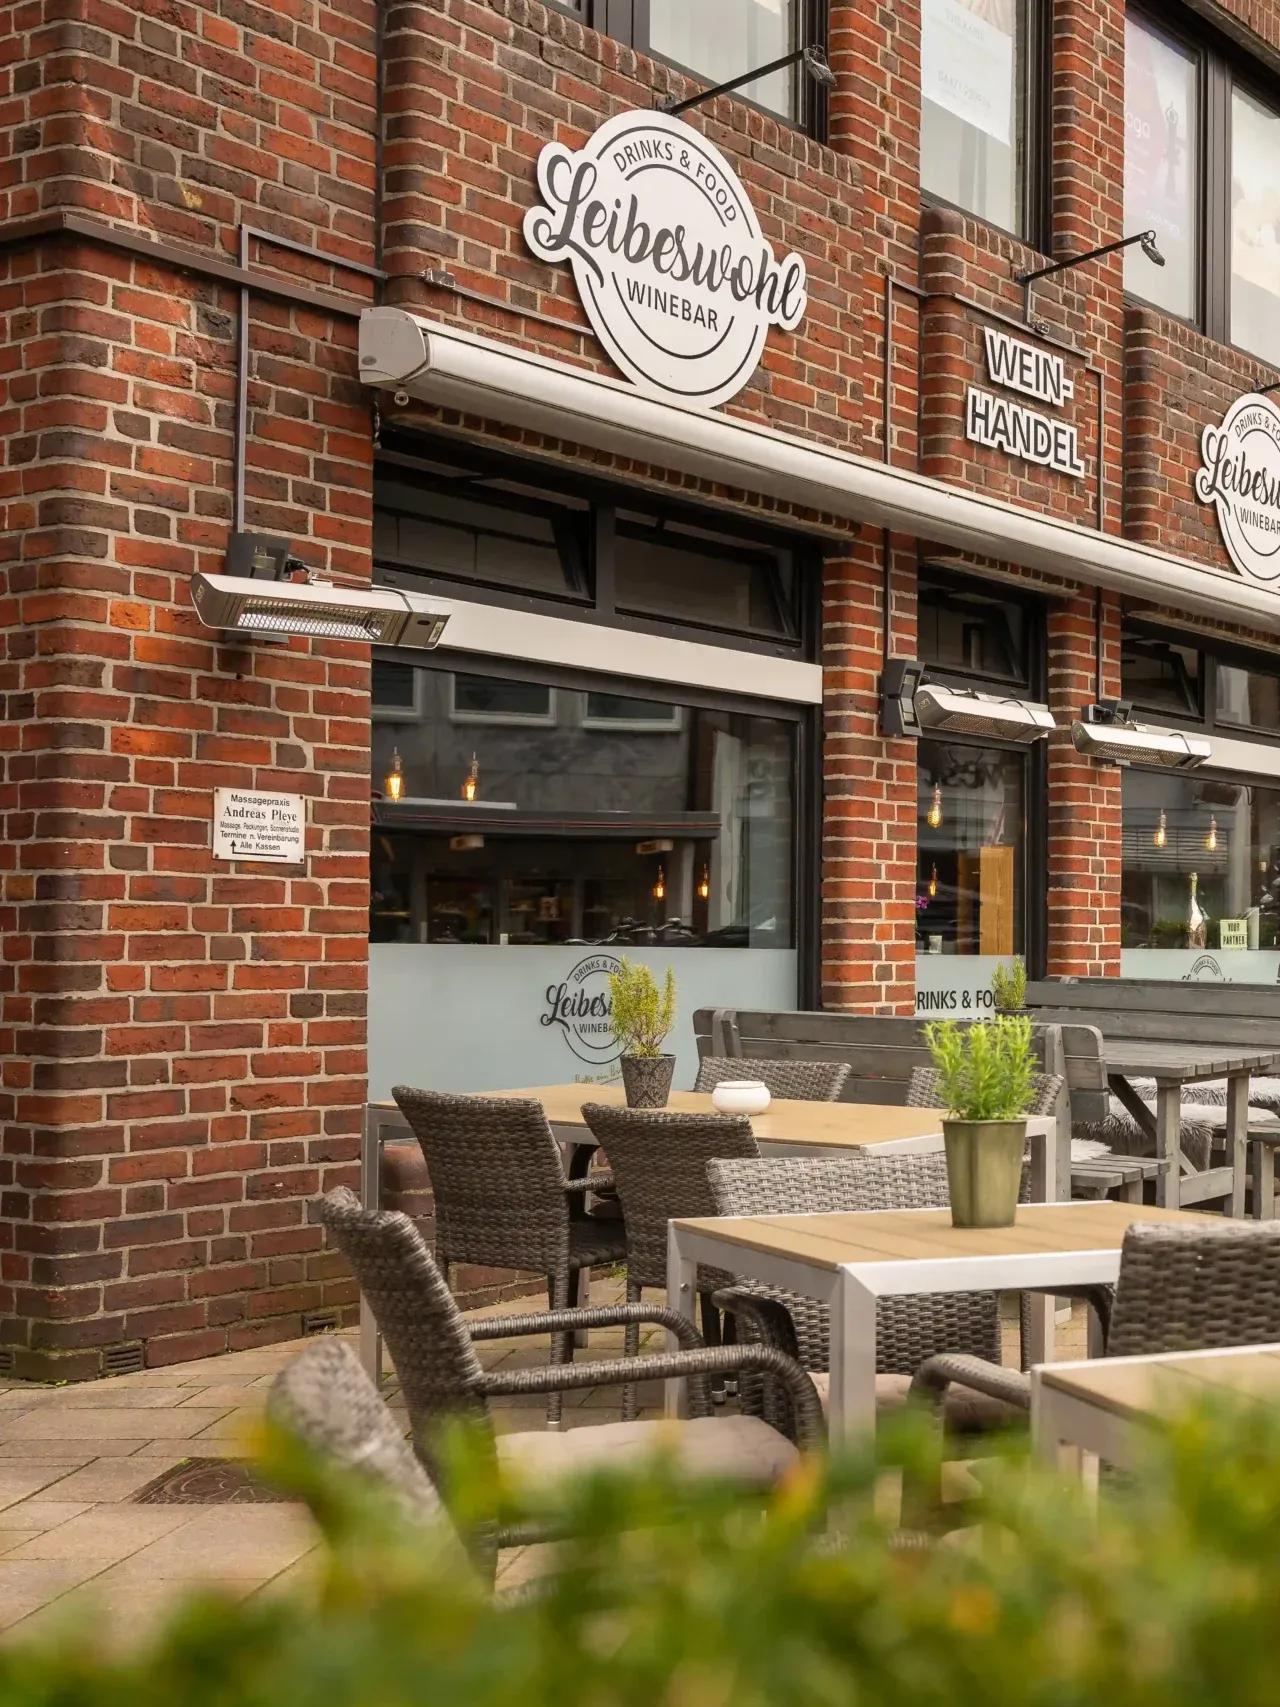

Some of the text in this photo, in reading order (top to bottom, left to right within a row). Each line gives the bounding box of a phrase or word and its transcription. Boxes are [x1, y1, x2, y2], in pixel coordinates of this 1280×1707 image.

[1126, 111, 1150, 138] oga
[613, 139, 737, 222] DRINKS & FOOD
[532, 154, 802, 321] Leibeswohl
[626, 277, 719, 332] WINEBAR
[988, 334, 1071, 400] WEIN-
[971, 393, 1082, 472] HANDEL
[1235, 412, 1262, 438] DRINKS
[1265, 416, 1271, 429] &
[230, 794, 291, 807] Massagepraxis
[223, 806, 298, 824] Andreas Pleye
[220, 830, 247, 839] Termine
[256, 833, 300, 844] Vereinbarung
[240, 841, 281, 851] Alle Kassen
[1227, 922, 1240, 932] YOUR
[1222, 935, 1245, 945] PARTNER
[573, 959, 600, 982] DRINKS
[602, 959, 608, 969] &
[1194, 958, 1206, 974] DRINKS
[540, 982, 612, 1033] Leibes
[914, 989, 997, 1010] RINKS & FO
